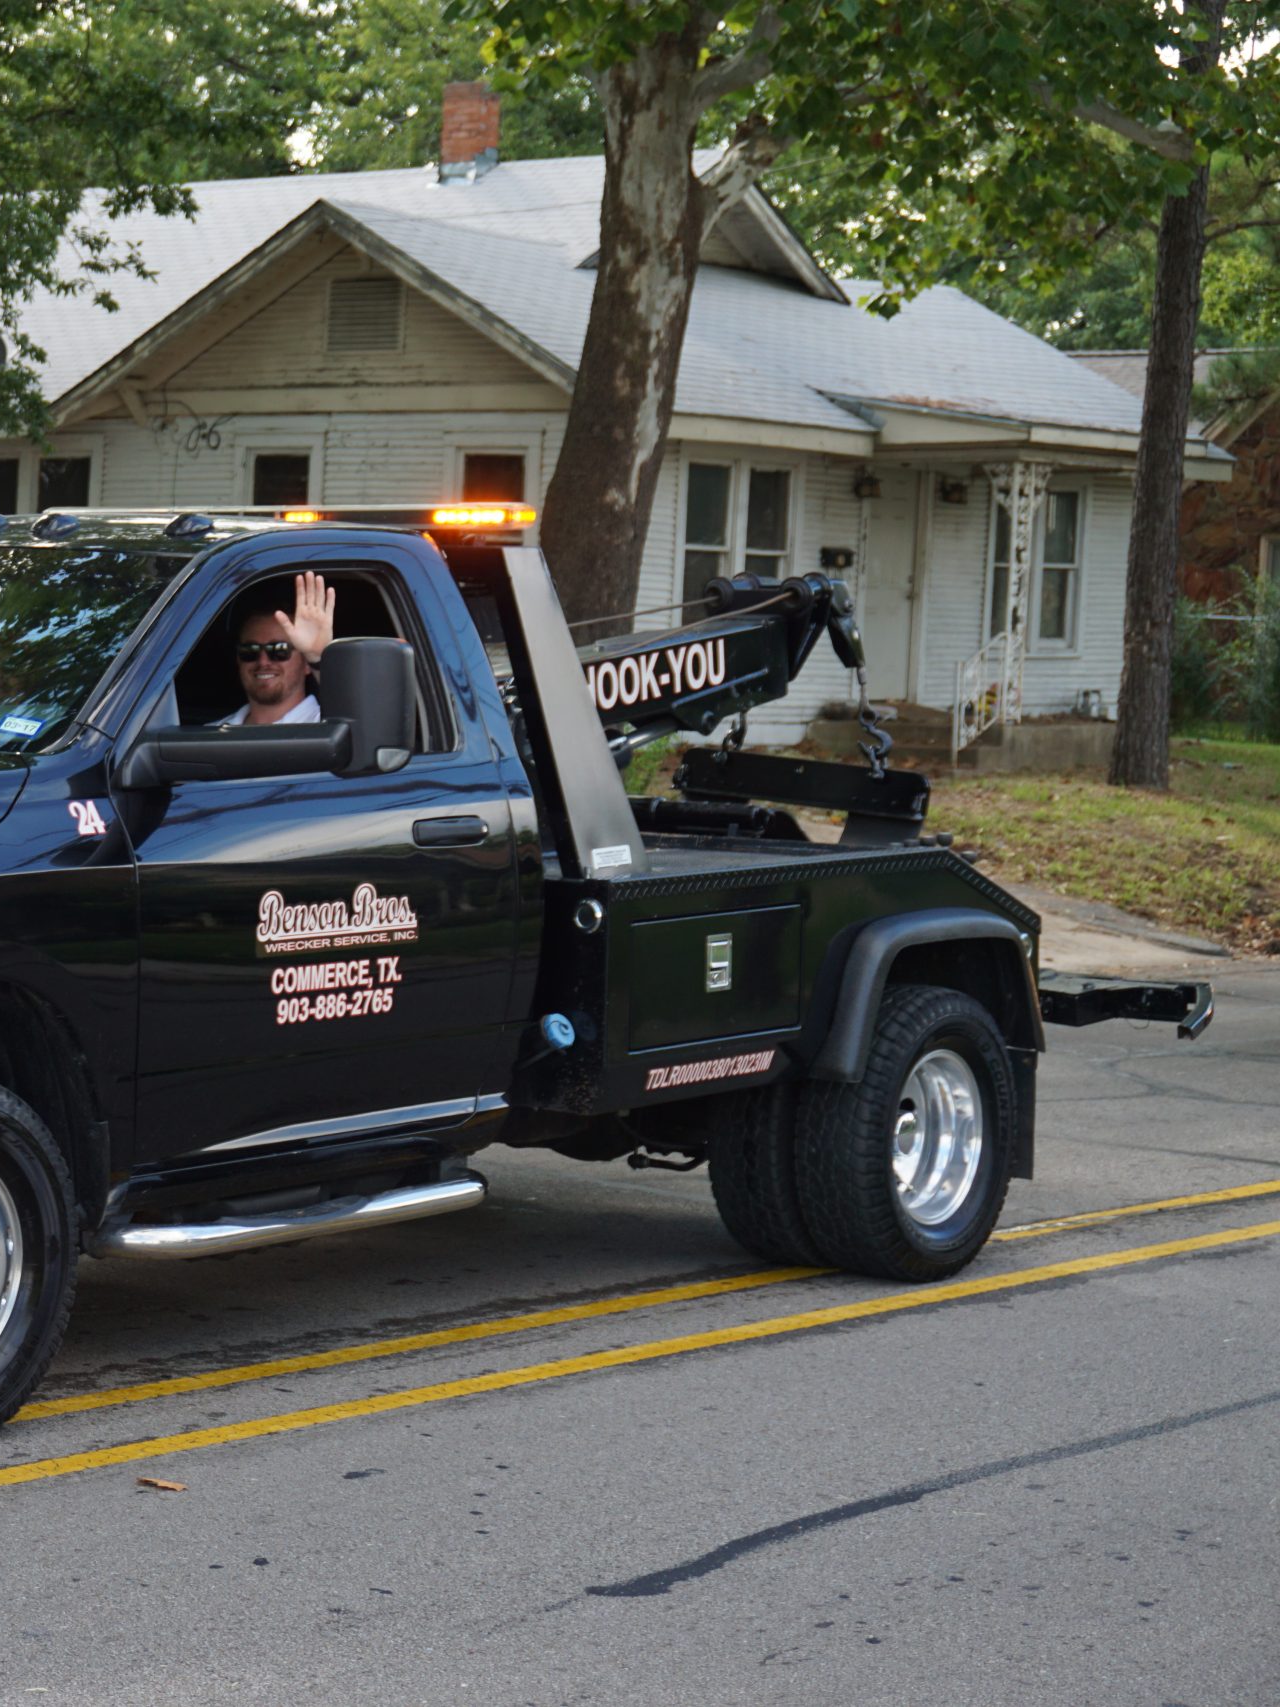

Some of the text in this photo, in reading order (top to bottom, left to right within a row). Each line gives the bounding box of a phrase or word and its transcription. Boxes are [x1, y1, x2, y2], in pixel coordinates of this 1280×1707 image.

[68, 800, 107, 836] 24
[256, 882, 418, 943] Benson Bros.
[265, 929, 418, 953] WRECKER SERVICE, INC.
[271, 956, 402, 995] COMMERCE, TX.
[276, 988, 394, 1025] 903-886-2765
